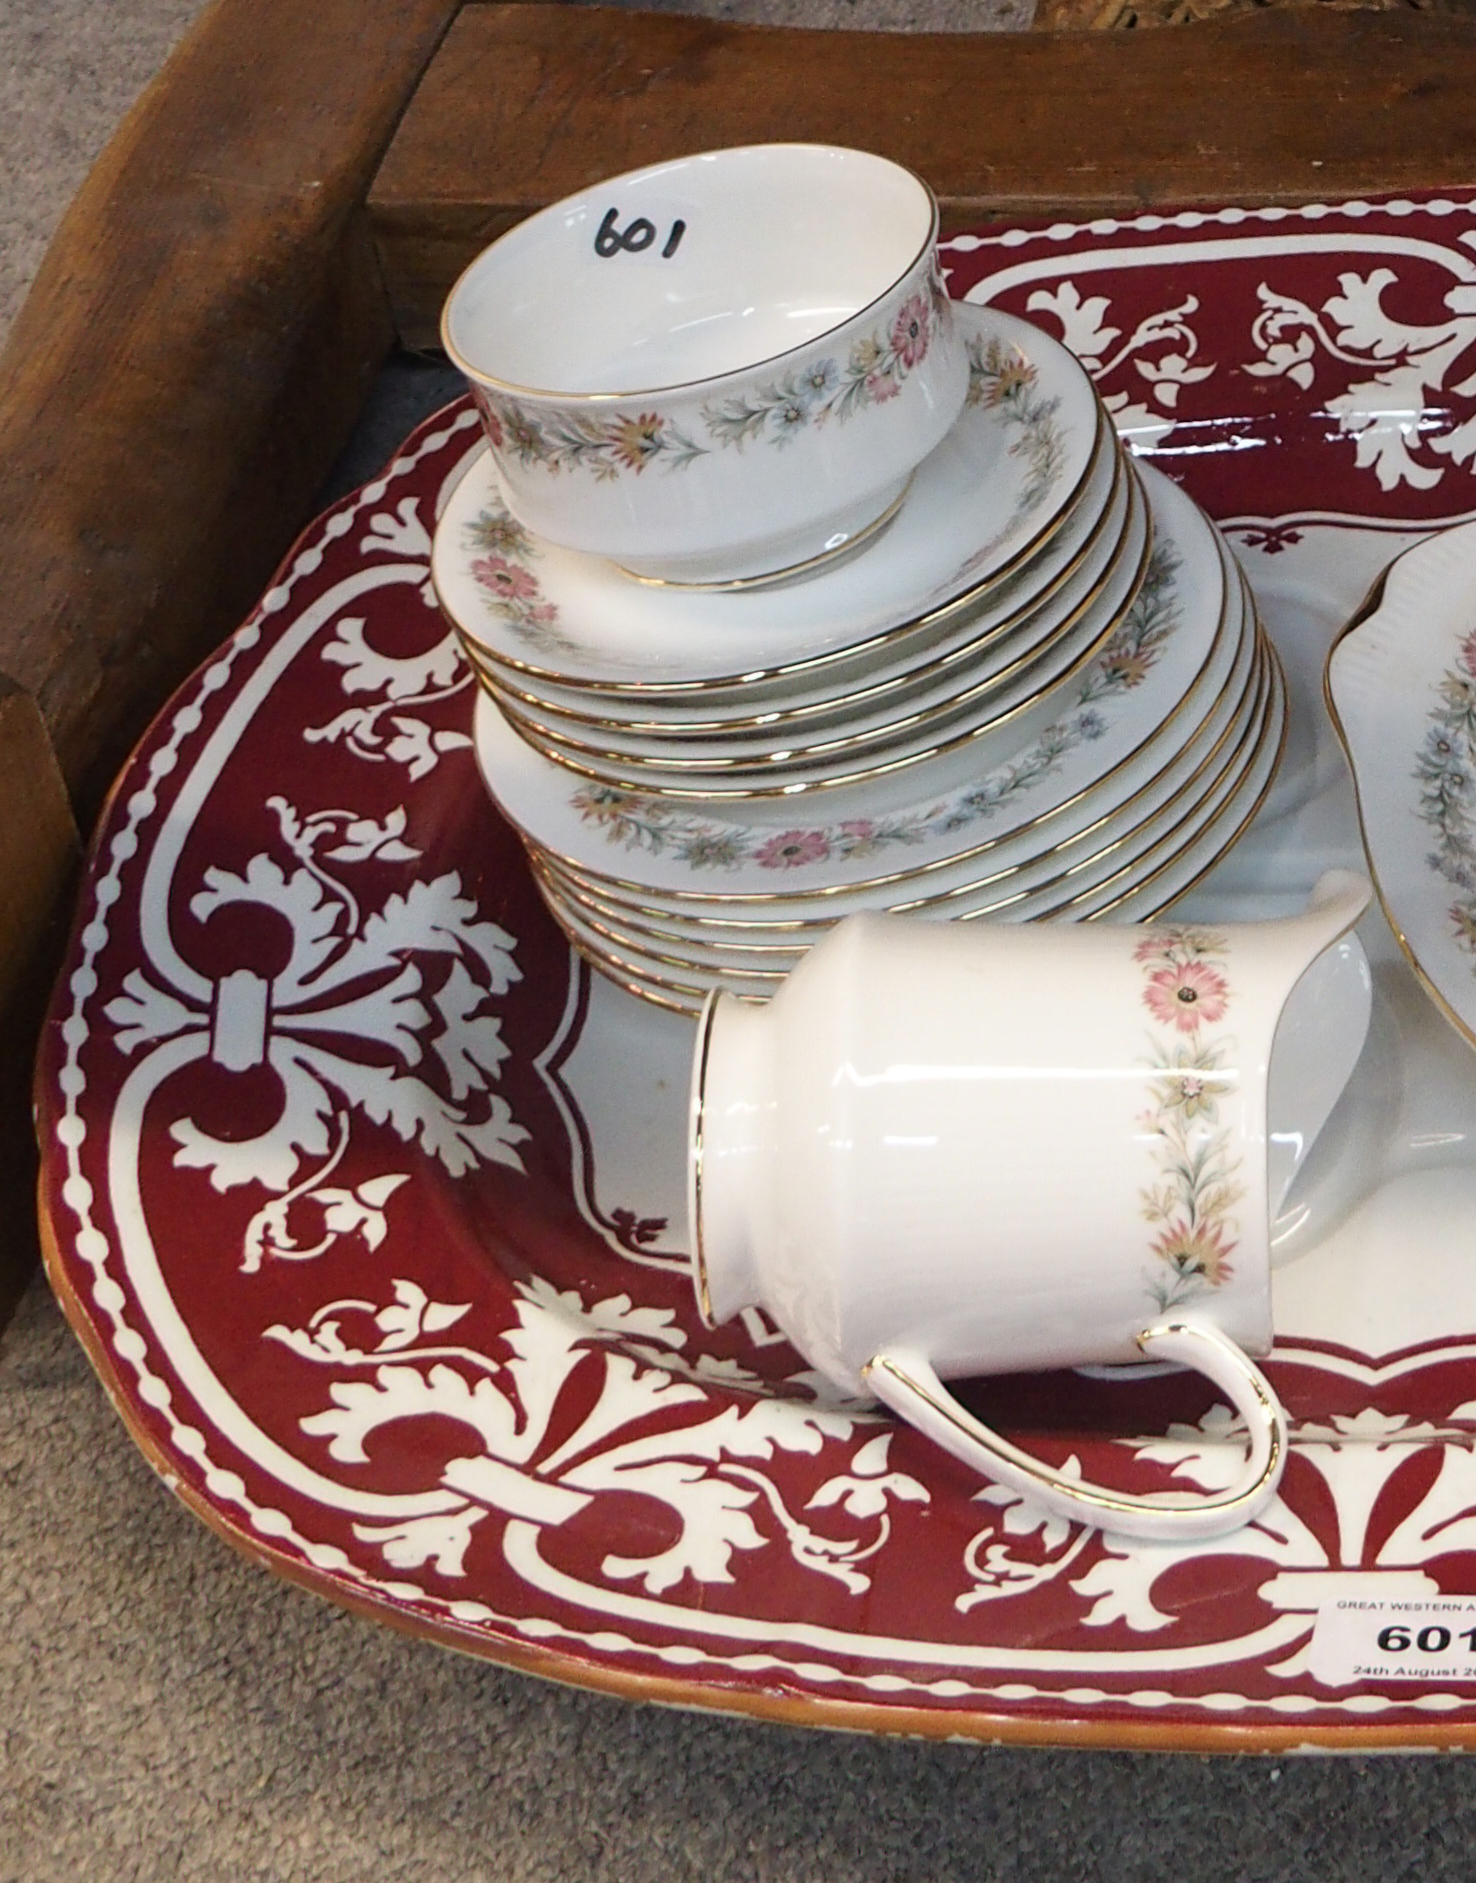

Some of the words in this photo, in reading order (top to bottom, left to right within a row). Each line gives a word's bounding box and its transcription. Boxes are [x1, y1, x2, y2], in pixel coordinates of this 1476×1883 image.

[594, 207, 687, 259] 601
[1336, 1600, 1385, 1611] GREAT
[1390, 1602, 1462, 1612] WESTERN
[1352, 1665, 1389, 1676] 24th
[1393, 1666, 1458, 1678] August
